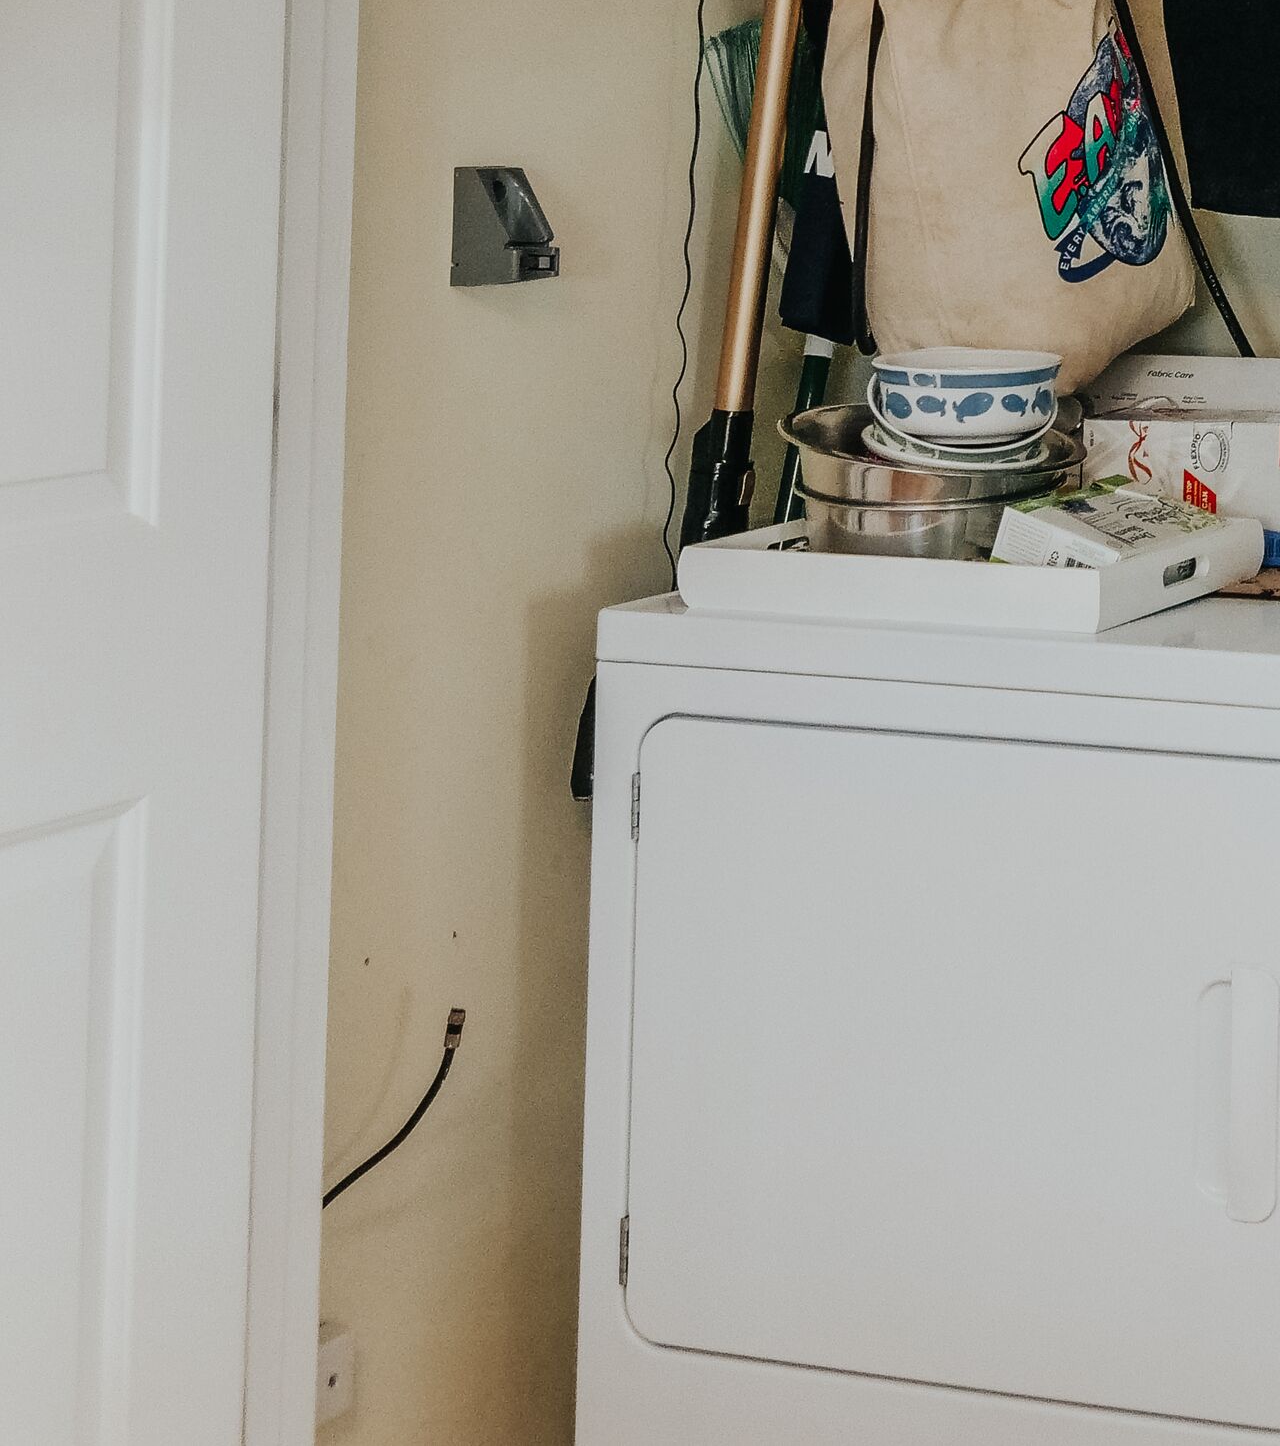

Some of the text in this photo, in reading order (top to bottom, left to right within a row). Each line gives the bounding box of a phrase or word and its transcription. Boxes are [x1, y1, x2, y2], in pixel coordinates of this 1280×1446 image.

[1059, 226, 1086, 271] EVERY
[1146, 370, 1195, 380] Fabric Care
